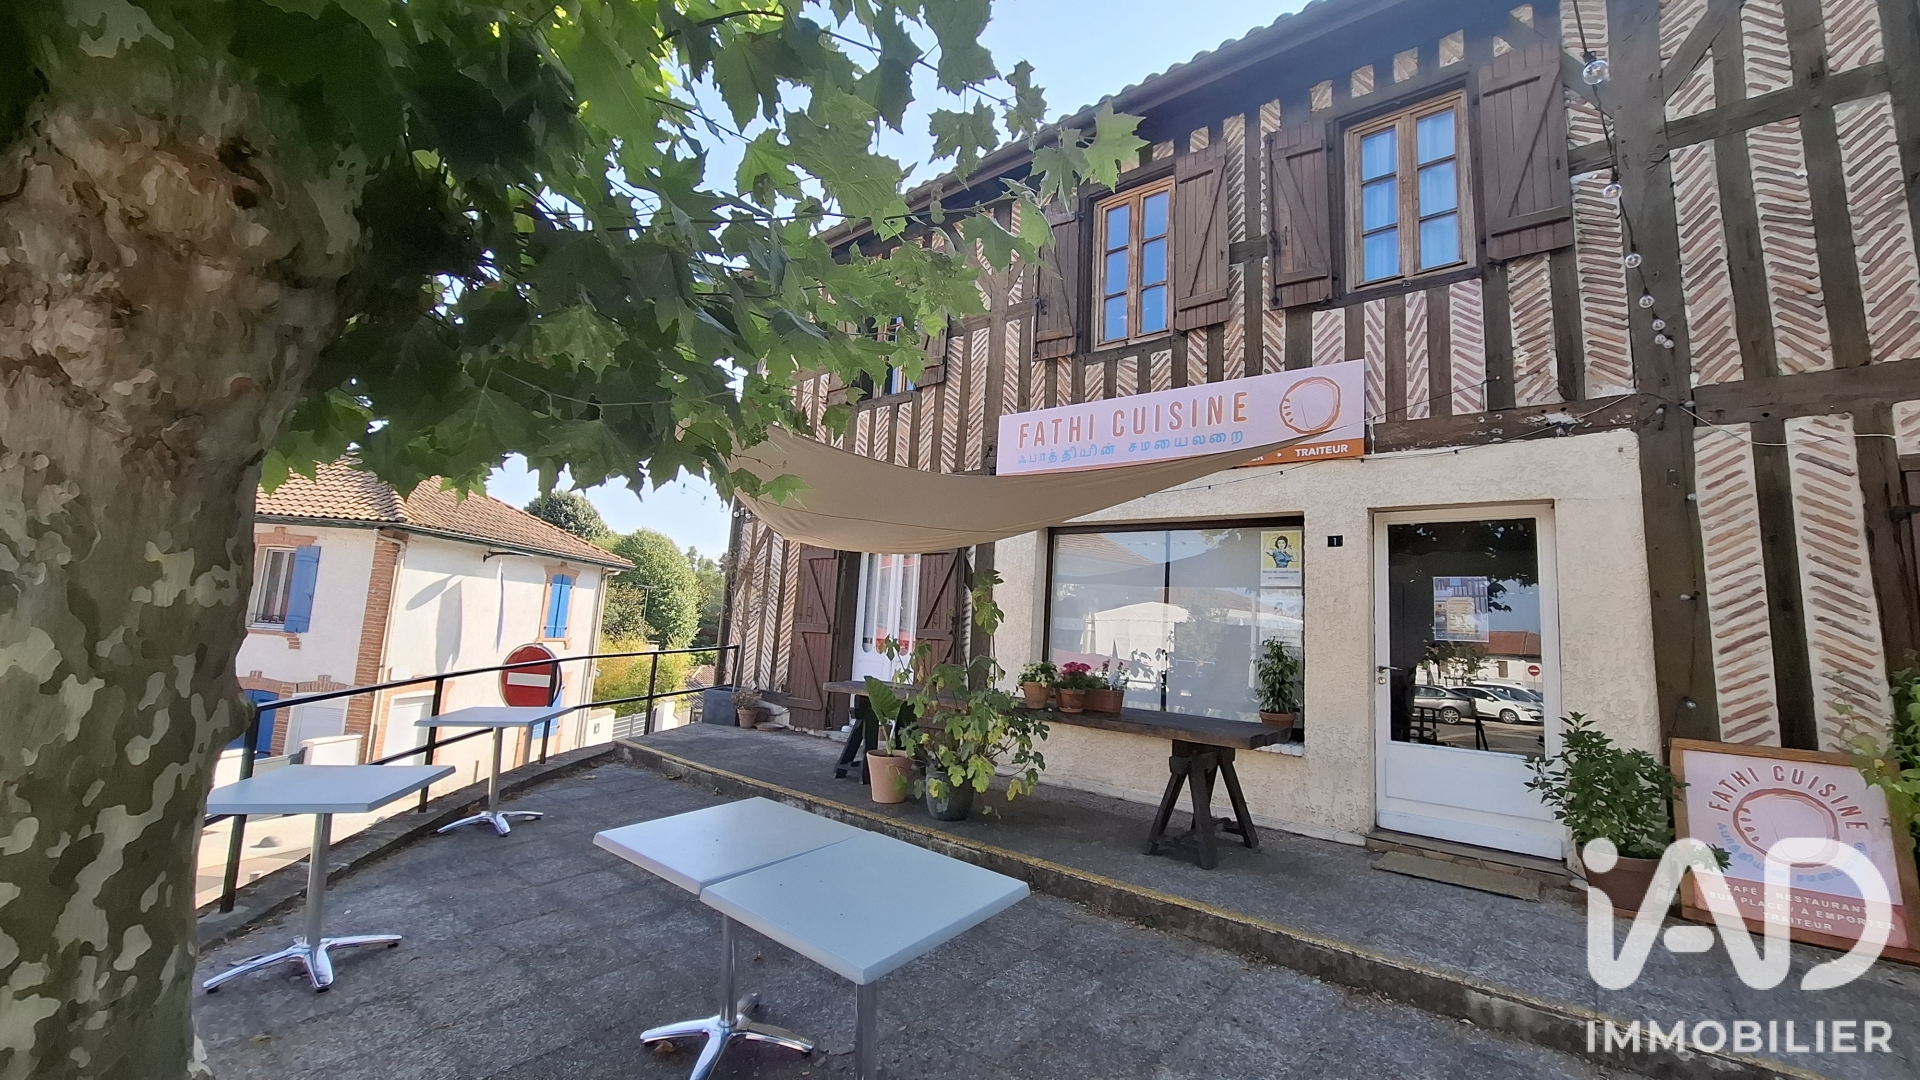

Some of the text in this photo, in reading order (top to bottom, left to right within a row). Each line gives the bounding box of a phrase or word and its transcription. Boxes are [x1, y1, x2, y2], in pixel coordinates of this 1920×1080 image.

[1018, 391, 1249, 450] FATHI CUISINE
[1295, 444, 1349, 457] TRAITEUR
[1708, 765, 1869, 831] FATHI CUISINE
[1709, 891, 1735, 902] SUR
[1740, 897, 1784, 911] PLACE
[1801, 905, 1809, 916] À
[1816, 910, 1896, 931] EMPORTER
[1724, 883, 1869, 914] CAFÉ RESTAURANT
[1763, 911, 1833, 931] TRAITEUR
